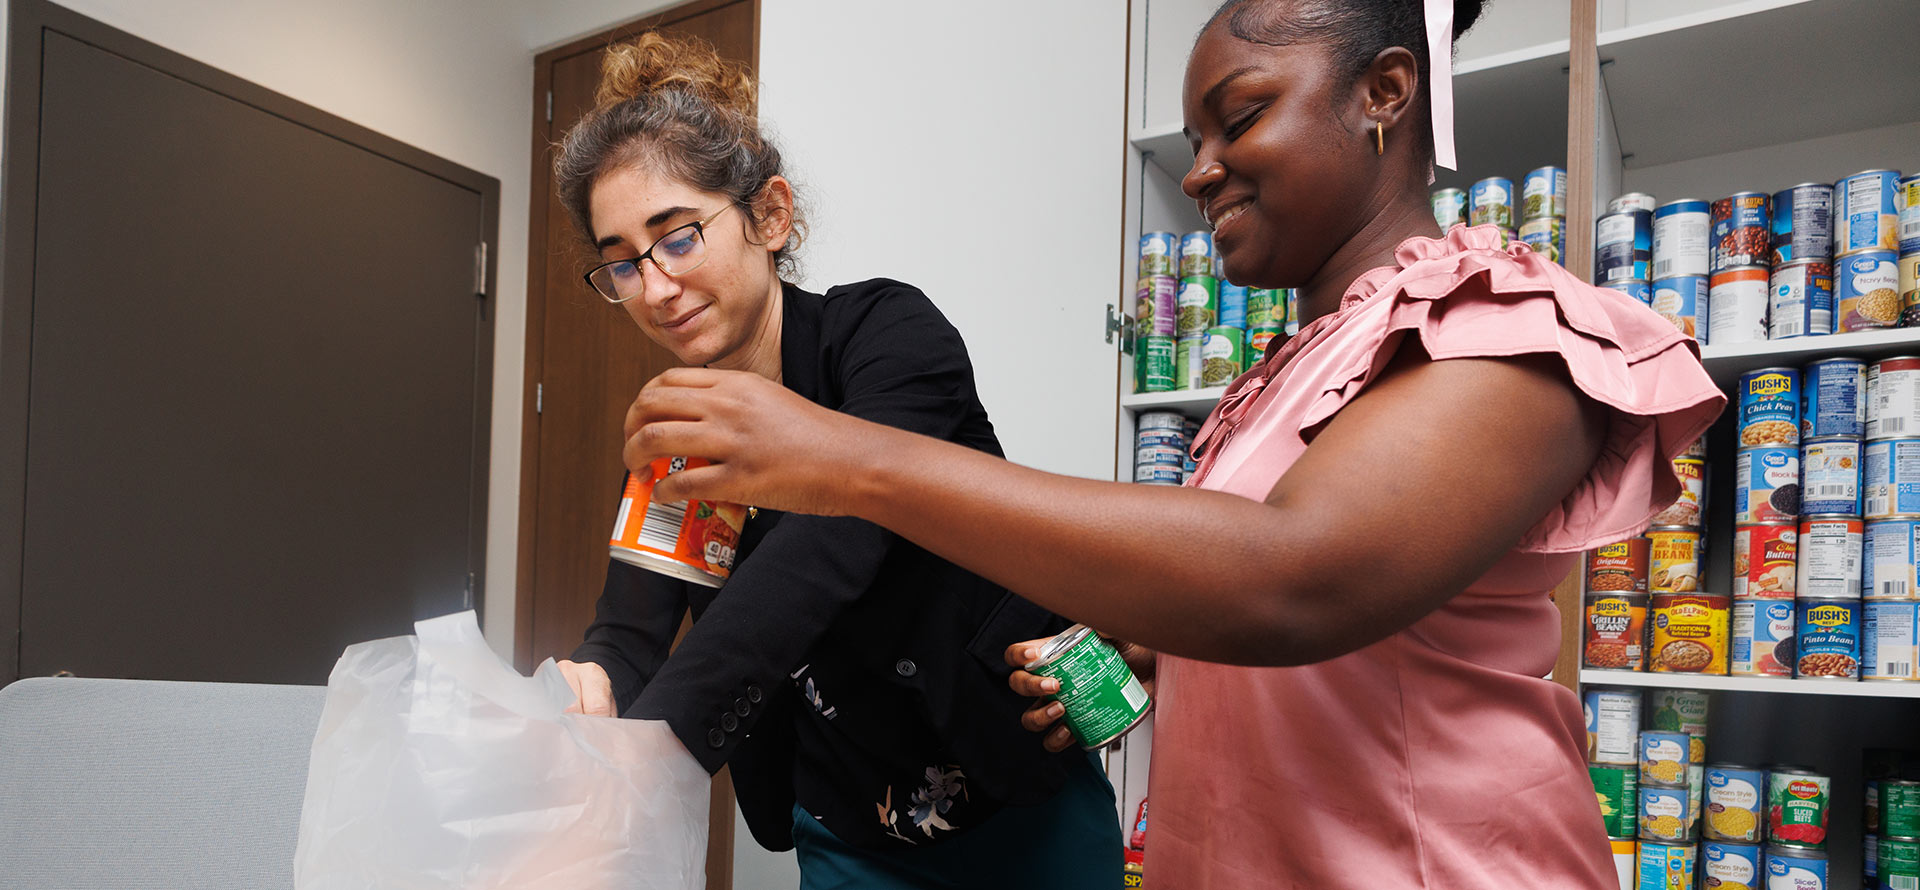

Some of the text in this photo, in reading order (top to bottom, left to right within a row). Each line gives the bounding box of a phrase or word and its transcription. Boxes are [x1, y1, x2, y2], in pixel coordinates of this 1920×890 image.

[1860, 276, 1881, 285] Navy
[1751, 378, 1790, 392] BUSH'S
[1747, 402, 1793, 414] Chick Peas
[1674, 463, 1698, 478] arita
[1599, 544, 1626, 554] BUSH'S
[1654, 549, 1692, 561] BEANS
[1766, 550, 1791, 559] Butter
[1597, 558, 1628, 567] Original
[1596, 602, 1627, 612] BUSH'S
[1591, 614, 1631, 625] GRILLIN'
[1809, 610, 1849, 622] BUSH'S
[1595, 623, 1627, 632] BEANS
[1803, 635, 1854, 645] Pinto Beans
[1676, 697, 1705, 705] Green
[1681, 705, 1705, 714] Giant
[1712, 788, 1753, 798] Cream Style
[1801, 785, 1818, 793] Monte
[1793, 808, 1813, 817] SLICED
[1794, 815, 1811, 823] BEETS
[1709, 861, 1749, 872] Cream Style
[1124, 873, 1143, 888] SP
[1794, 878, 1817, 886] Sliced
